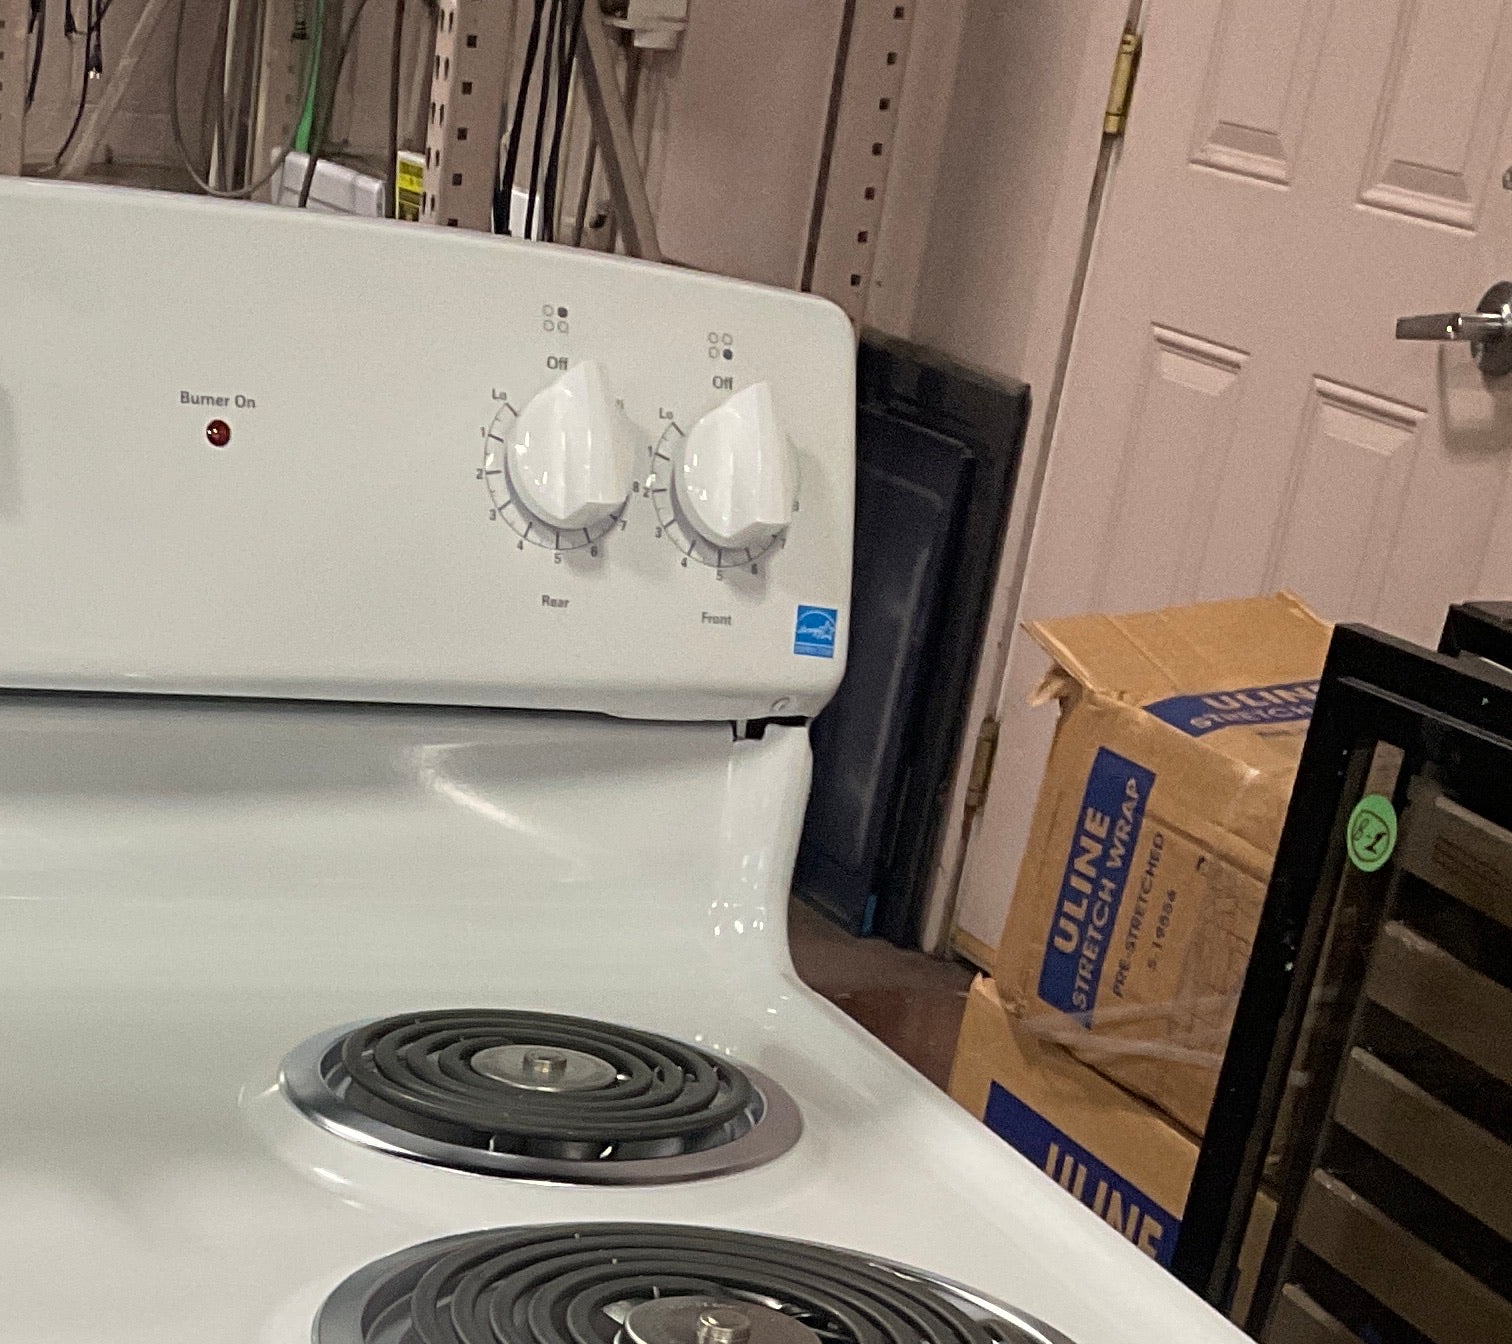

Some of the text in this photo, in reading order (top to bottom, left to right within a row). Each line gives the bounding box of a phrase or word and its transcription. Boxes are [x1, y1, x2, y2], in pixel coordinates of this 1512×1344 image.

[546, 356, 568, 370] Off
[712, 376, 733, 390] Off
[180, 390, 256, 408] Burner On
[492, 388, 507, 401] Lo
[659, 407, 674, 420] Lo
[480, 427, 486, 437] 1
[647, 446, 653, 456] 1
[476, 468, 483, 479] 2
[633, 481, 640, 493] 8
[489, 509, 496, 520] 3
[620, 520, 627, 531] 7
[655, 527, 662, 539] 3
[517, 540, 524, 551] 4
[590, 545, 597, 557] 6
[554, 552, 561, 564] 5
[681, 556, 688, 568] 4
[716, 569, 723, 581] 5
[541, 595, 570, 608] Rear
[701, 612, 732, 625] Front
[1202, 684, 1319, 710] ULIN
[1053, 807, 1110, 954] ULINE
[1072, 777, 1140, 1011] STRETCH WRAP
